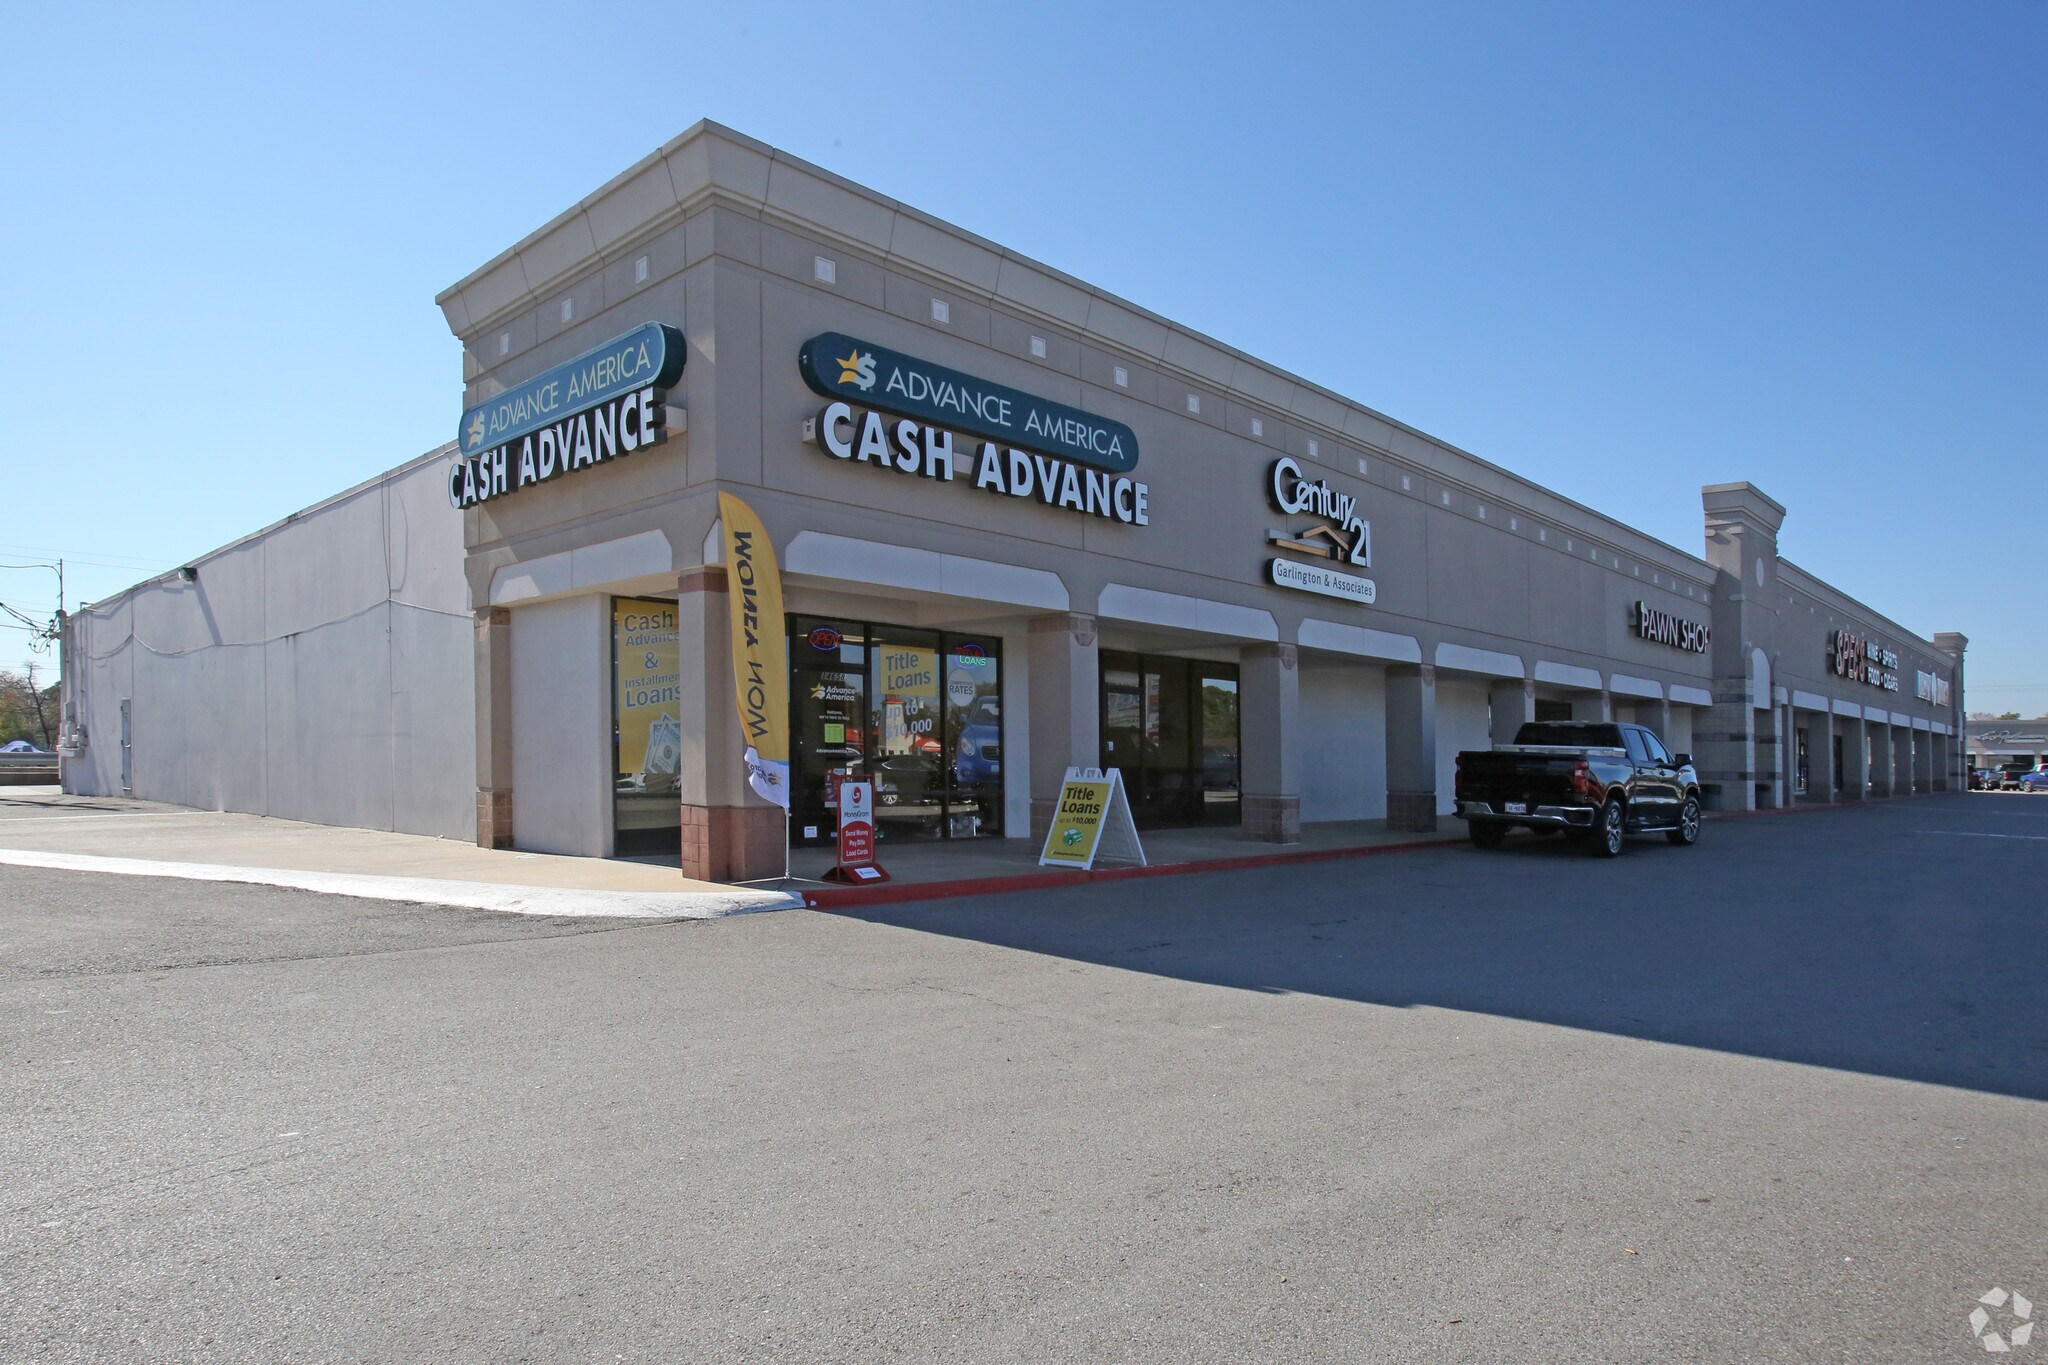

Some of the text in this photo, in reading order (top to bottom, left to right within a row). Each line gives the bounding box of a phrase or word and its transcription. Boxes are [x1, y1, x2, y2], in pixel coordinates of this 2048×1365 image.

[489, 341, 651, 437] ADVANCE AMERICA
[885, 366, 1125, 460] ADVANCE AMERICA
[449, 387, 656, 509] CASH ADVANCE
[819, 401, 1149, 526] CASH ADVANCE
[1273, 456, 1372, 568] Century 21
[1276, 563, 1373, 597] Garlington & Associates
[624, 609, 673, 633] Cash
[1639, 600, 1710, 654] PAWN SHOP
[625, 631, 680, 647] Advance
[809, 631, 840, 648] OPEN
[644, 651, 659, 669] &
[885, 652, 919, 672] Title
[959, 655, 986, 666] LOANS
[625, 672, 680, 689] Installmen
[887, 671, 931, 691] Loans
[1867, 666, 1880, 686] FOOD
[626, 685, 681, 708] Loans
[825, 685, 856, 694] Advance
[948, 684, 974, 695] RATES
[885, 717, 933, 740] $10000
[1066, 787, 1095, 801] Title
[844, 810, 870, 820] MoneyGram
[1061, 801, 1101, 815] Loans
[1072, 816, 1097, 825] $10,000
[846, 849, 857, 857] Load
[848, 840, 857, 848] Pay
